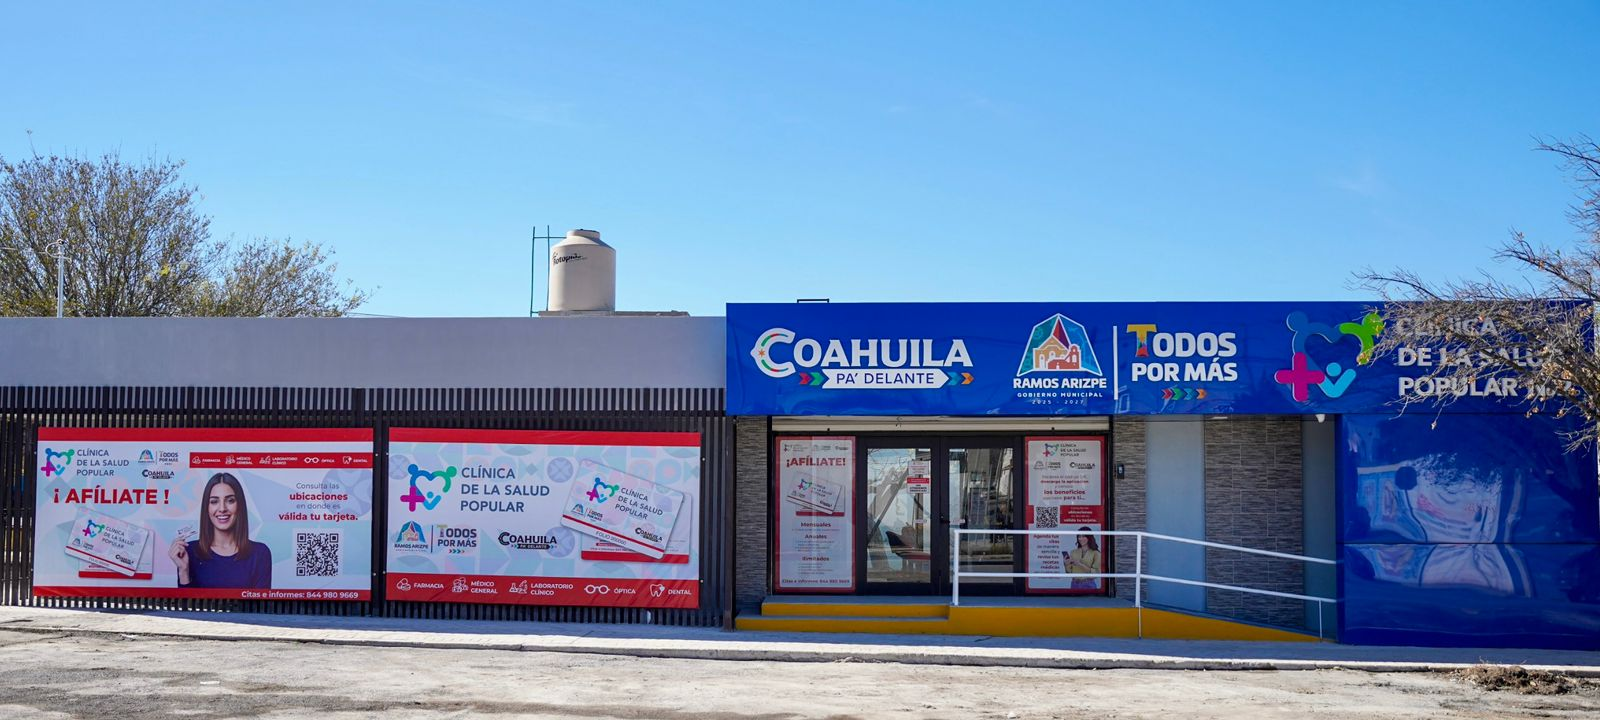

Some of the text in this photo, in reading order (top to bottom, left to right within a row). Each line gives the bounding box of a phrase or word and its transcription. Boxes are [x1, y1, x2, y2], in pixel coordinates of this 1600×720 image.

[1127, 324, 1237, 357] TODOS
[750, 327, 974, 378] COAHUILA
[1398, 347, 1557, 367] DE LA SALU
[1131, 357, 1238, 382] POR MÁS
[864, 372, 934, 384] DELANTE
[1013, 378, 1107, 389] RAMOS ARIZPE
[1398, 376, 1518, 397] POPULAR
[77, 448, 109, 457] CLÍNICA
[786, 455, 846, 467] ¡AFÍLIATE!
[77, 469, 115, 477] POPULAR
[461, 465, 516, 479] CLÍNICA
[296, 482, 340, 490] Consulta las
[461, 484, 550, 496] DE LA SALUD
[65, 485, 158, 505] AFÍLIATE
[289, 492, 348, 501] ubicaciones
[621, 487, 648, 502] CLÍNICA
[460, 500, 525, 512] POPULAR
[615, 503, 648, 520] POPULAR
[618, 495, 663, 516] DE LA SALUD
[279, 512, 308, 520] válida
[323, 512, 358, 522] tarjeta.
[437, 524, 477, 538] TODOS
[437, 538, 477, 548] POR MÁS
[498, 531, 557, 546] COAHUILA
[241, 590, 260, 598] Citas
